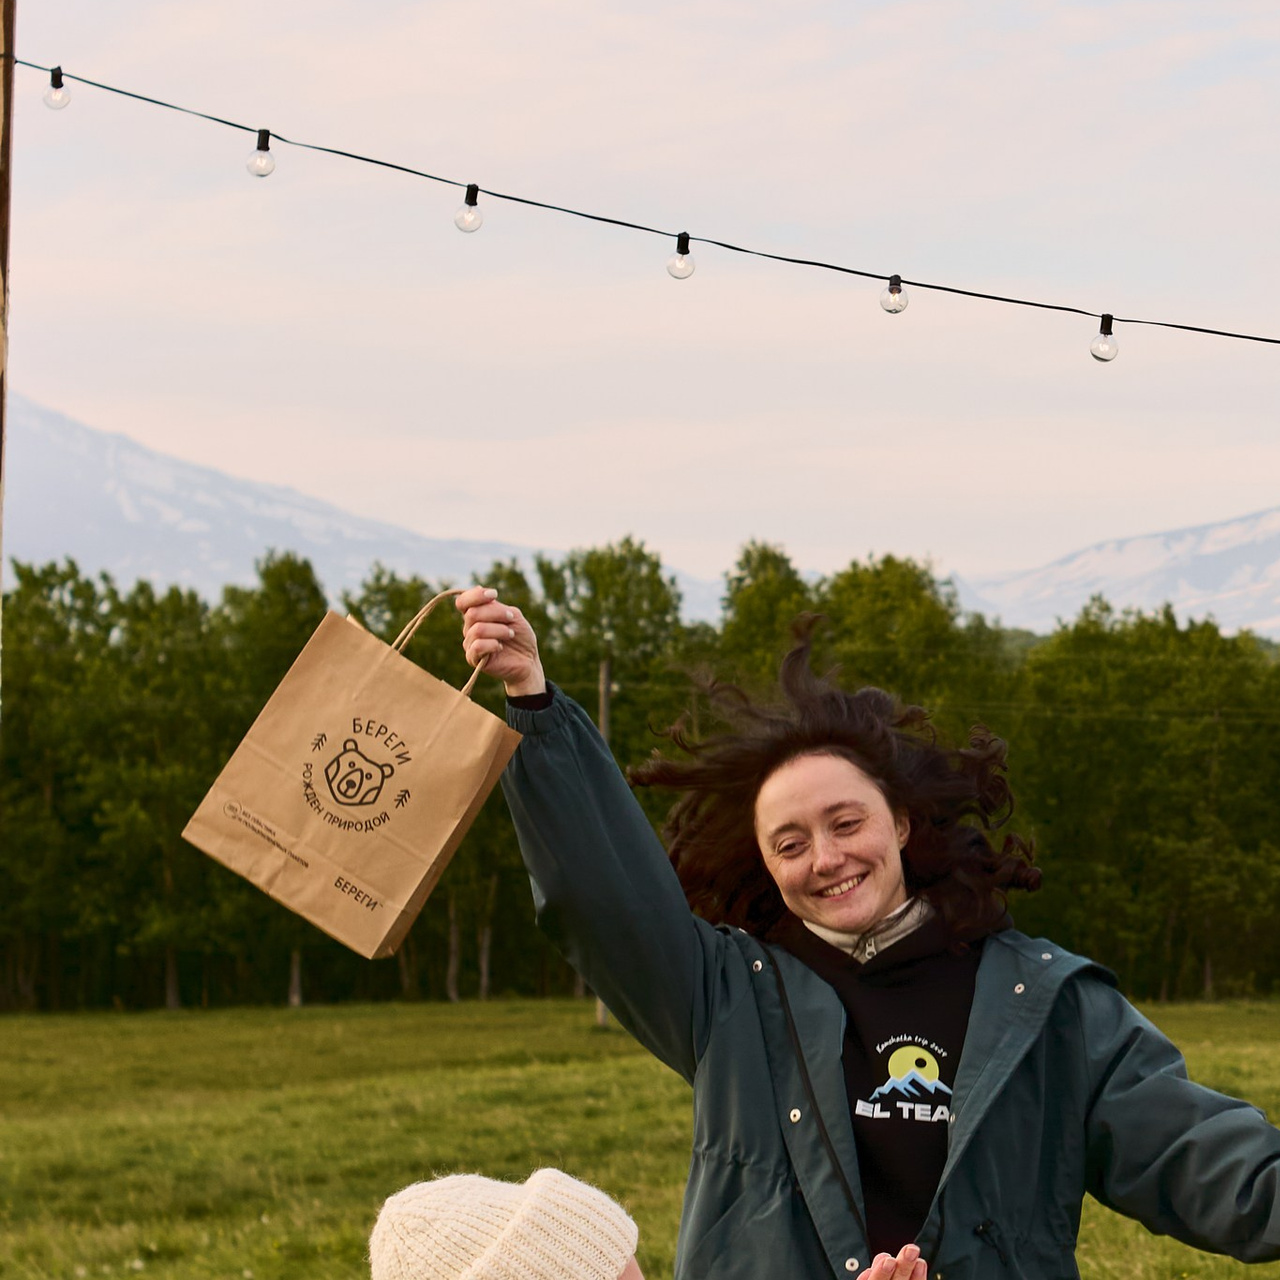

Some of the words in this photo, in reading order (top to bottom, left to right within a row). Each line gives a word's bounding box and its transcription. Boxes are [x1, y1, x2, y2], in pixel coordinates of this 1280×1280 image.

[353, 717, 412, 766] БЕРЕГИ
[302, 762, 325, 815] РОЖДЕН
[323, 811, 391, 834] ПРИРОДОЙ
[914, 1035, 929, 1047] trip
[855, 1099, 891, 1118] EL
